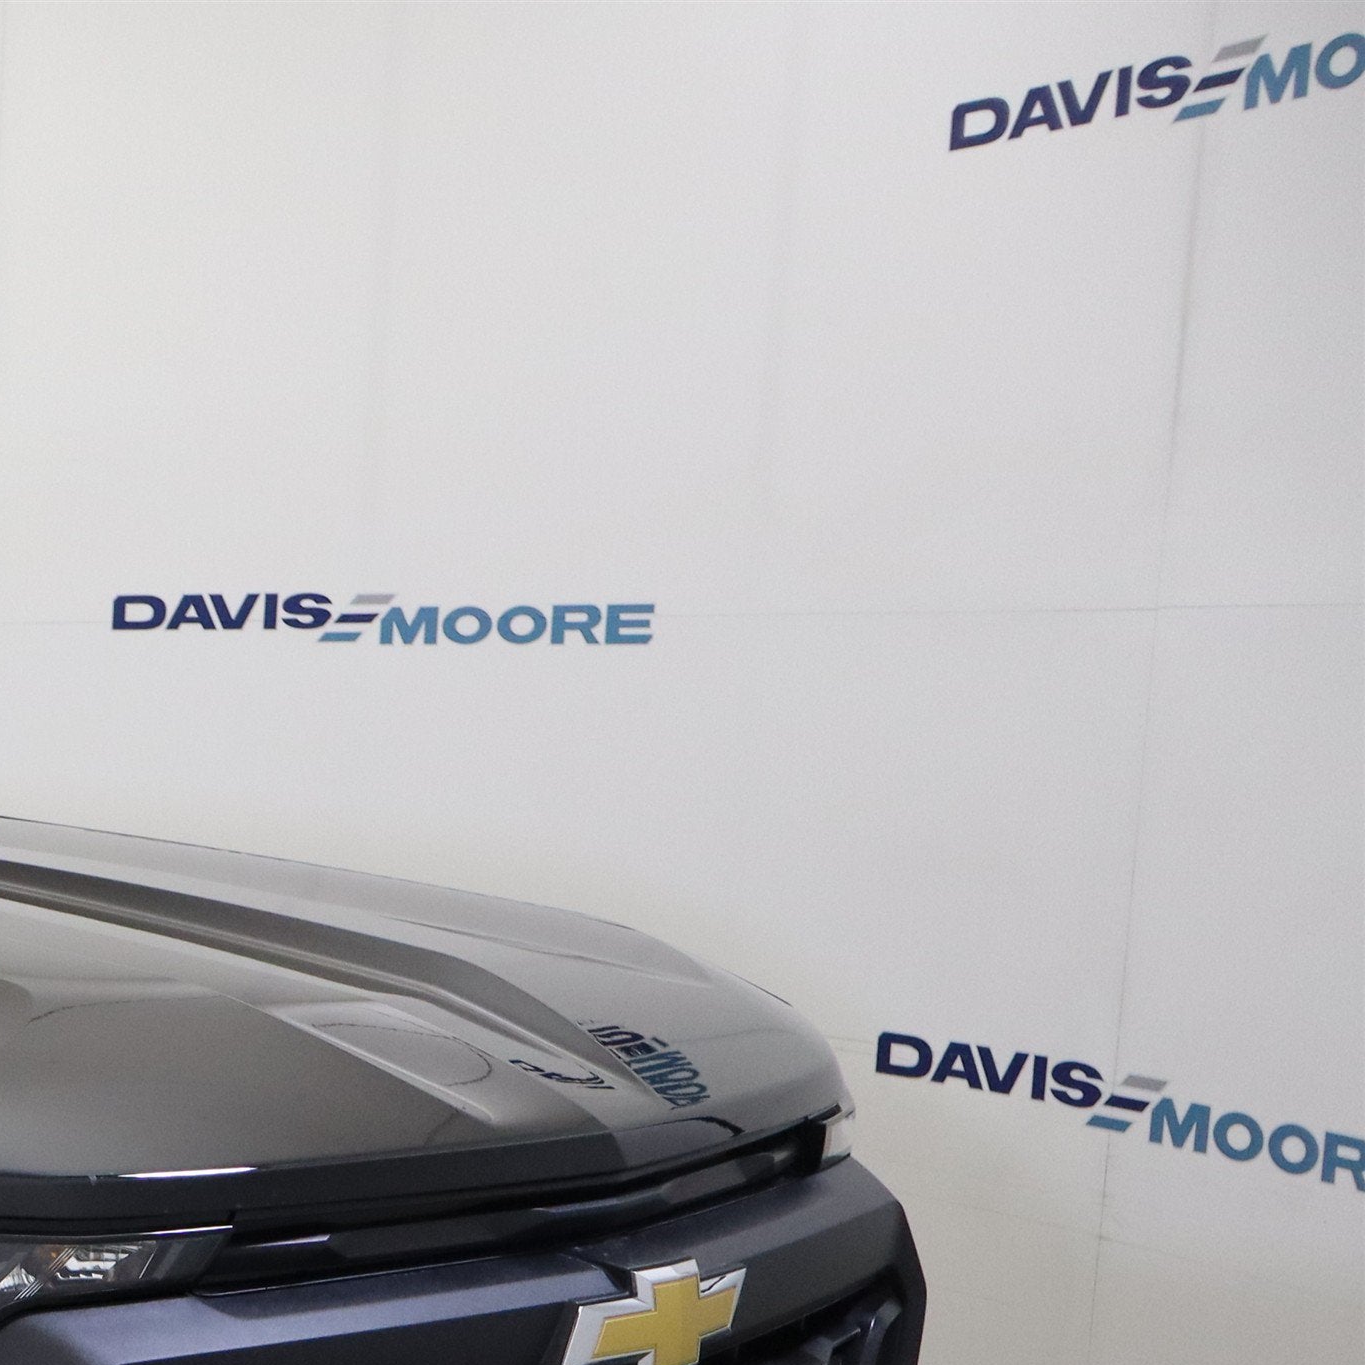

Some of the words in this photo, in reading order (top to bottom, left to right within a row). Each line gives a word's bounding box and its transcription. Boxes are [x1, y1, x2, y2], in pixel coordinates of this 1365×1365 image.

[950, 55, 1192, 151] DAVIS
[111, 592, 332, 630] DAVIS
[378, 602, 655, 646] MOORE
[875, 1030, 1104, 1108] DAVIS
[1148, 1096, 1365, 1192] MOOR
